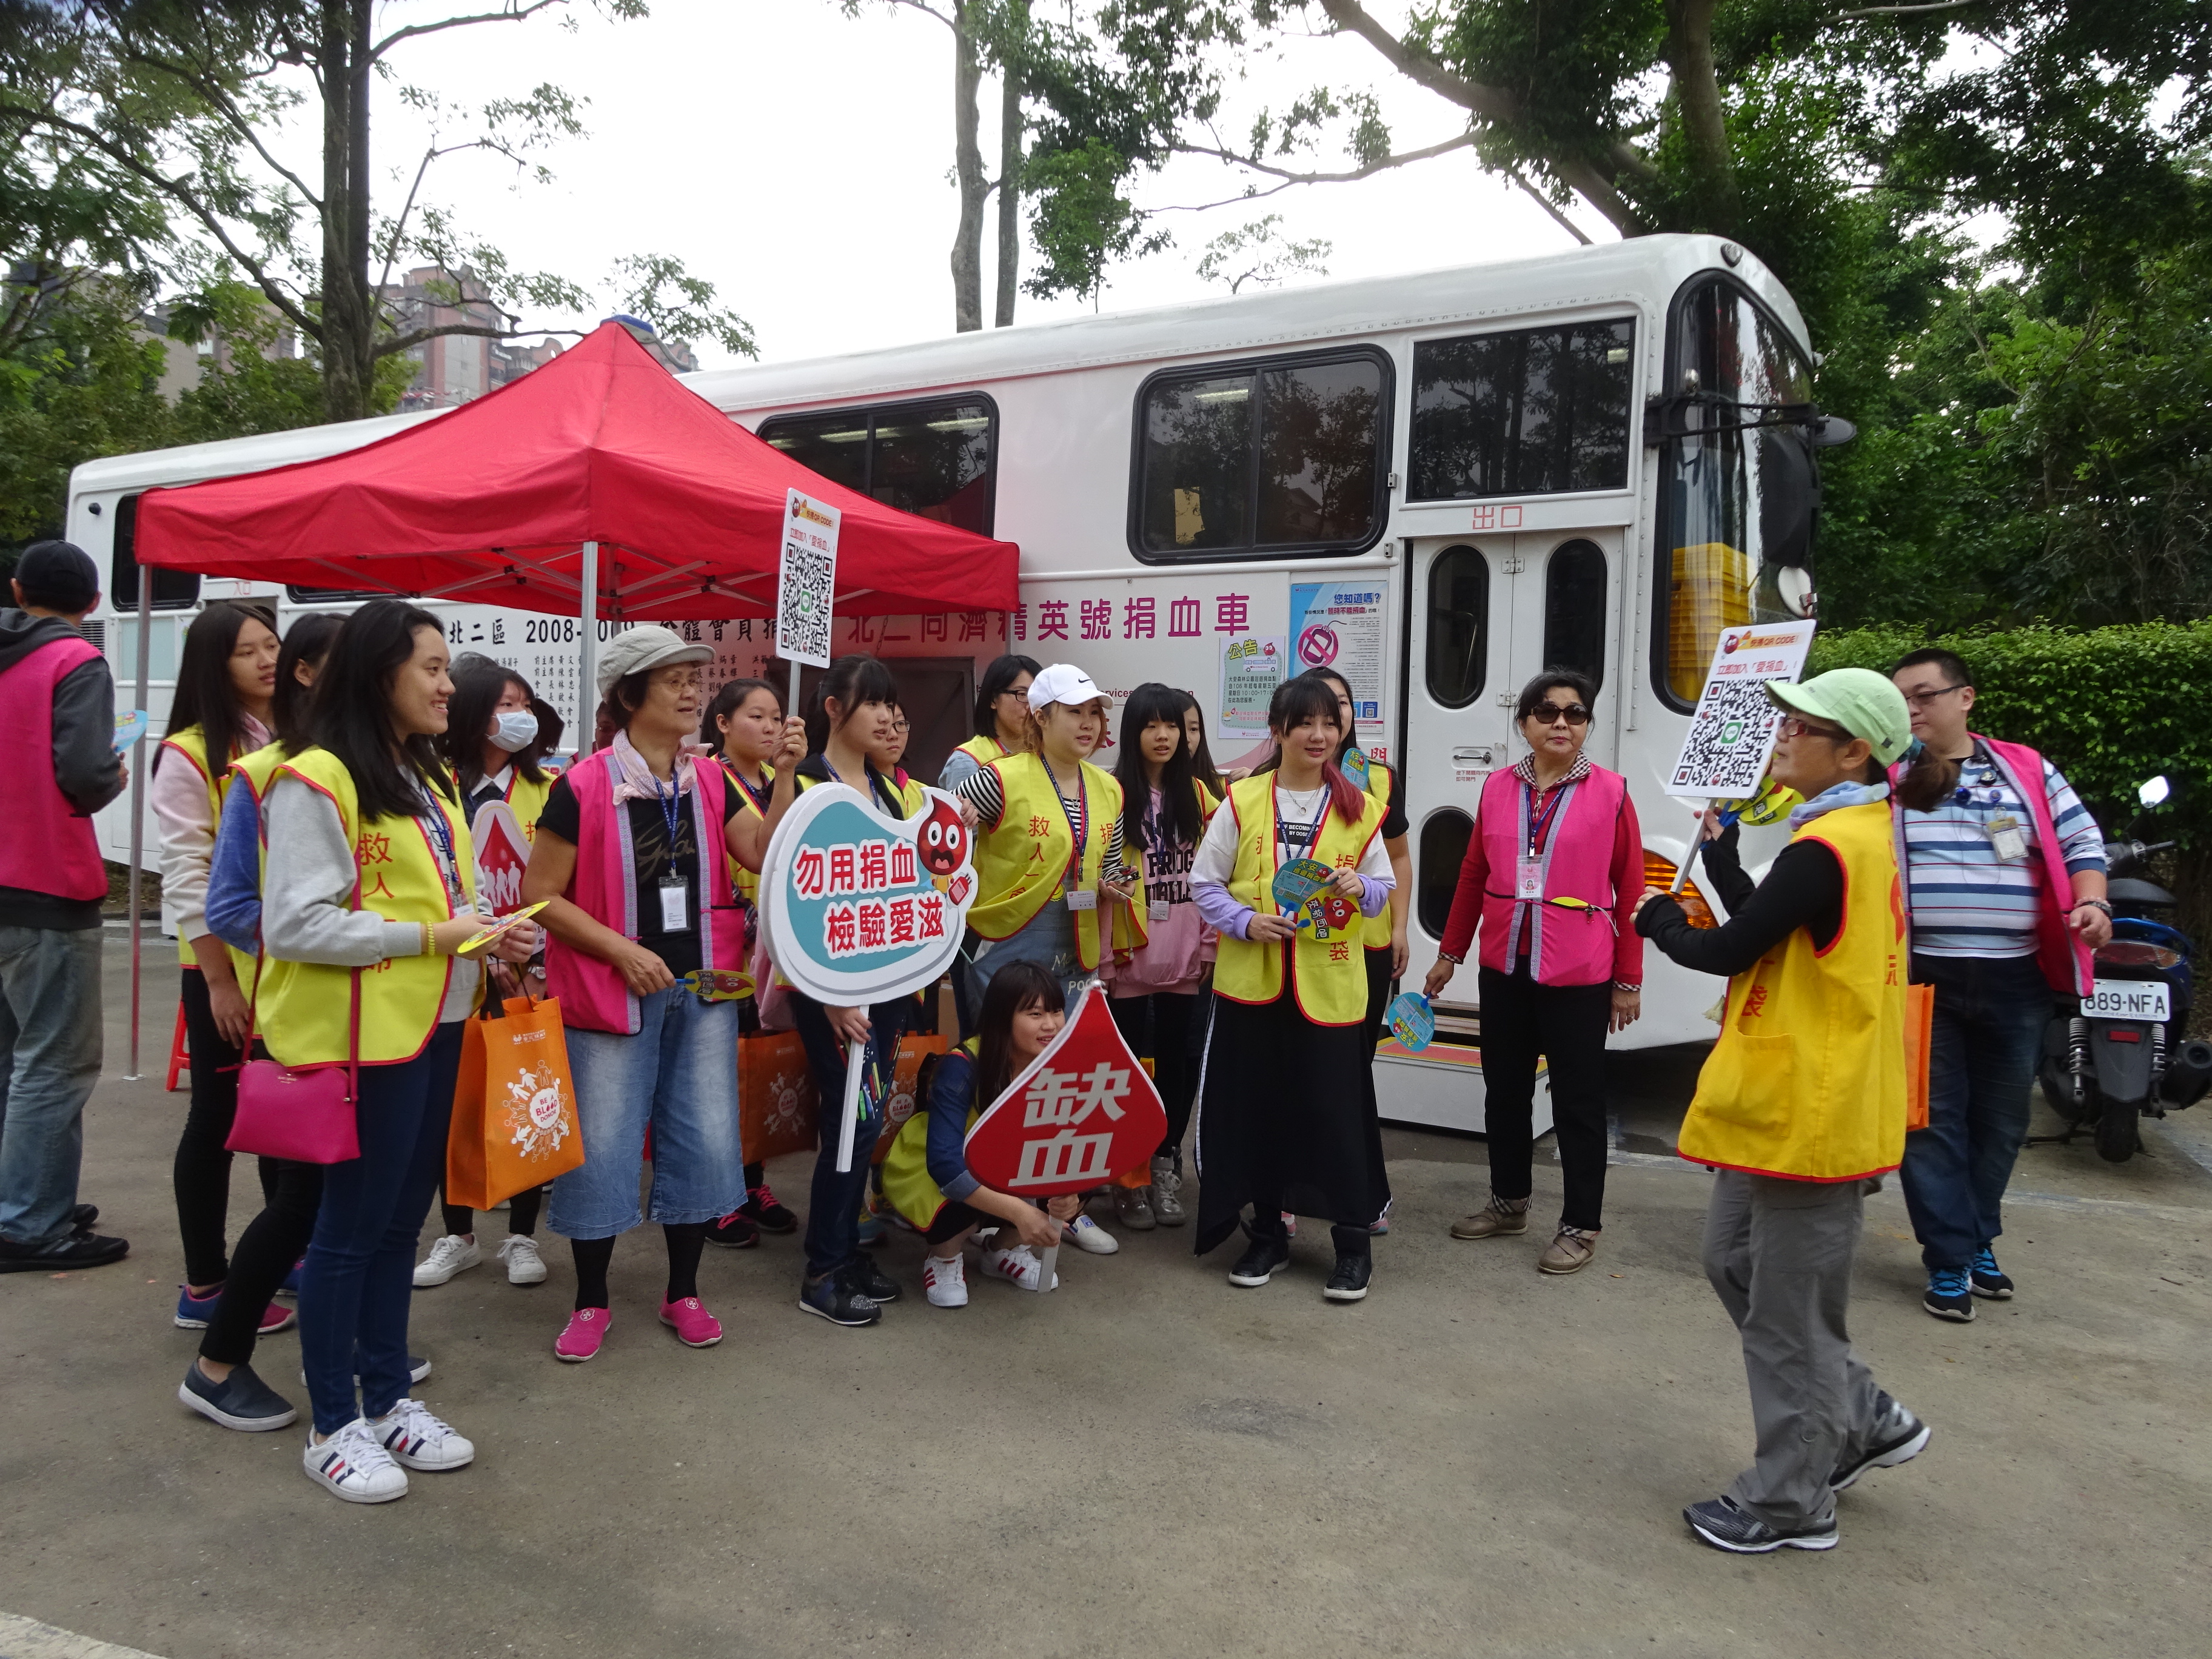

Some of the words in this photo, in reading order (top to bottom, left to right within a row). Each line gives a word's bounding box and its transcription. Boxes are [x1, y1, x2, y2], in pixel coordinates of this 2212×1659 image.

[1473, 506, 1522, 529] 出口
[1228, 638, 1258, 660] 公告
[796, 842, 916, 895] 勿用捐血
[827, 895, 944, 953] 檢驗愛滋
[536, 1100, 558, 1116] BLOOD
[540, 1110, 557, 1122] DONOR
